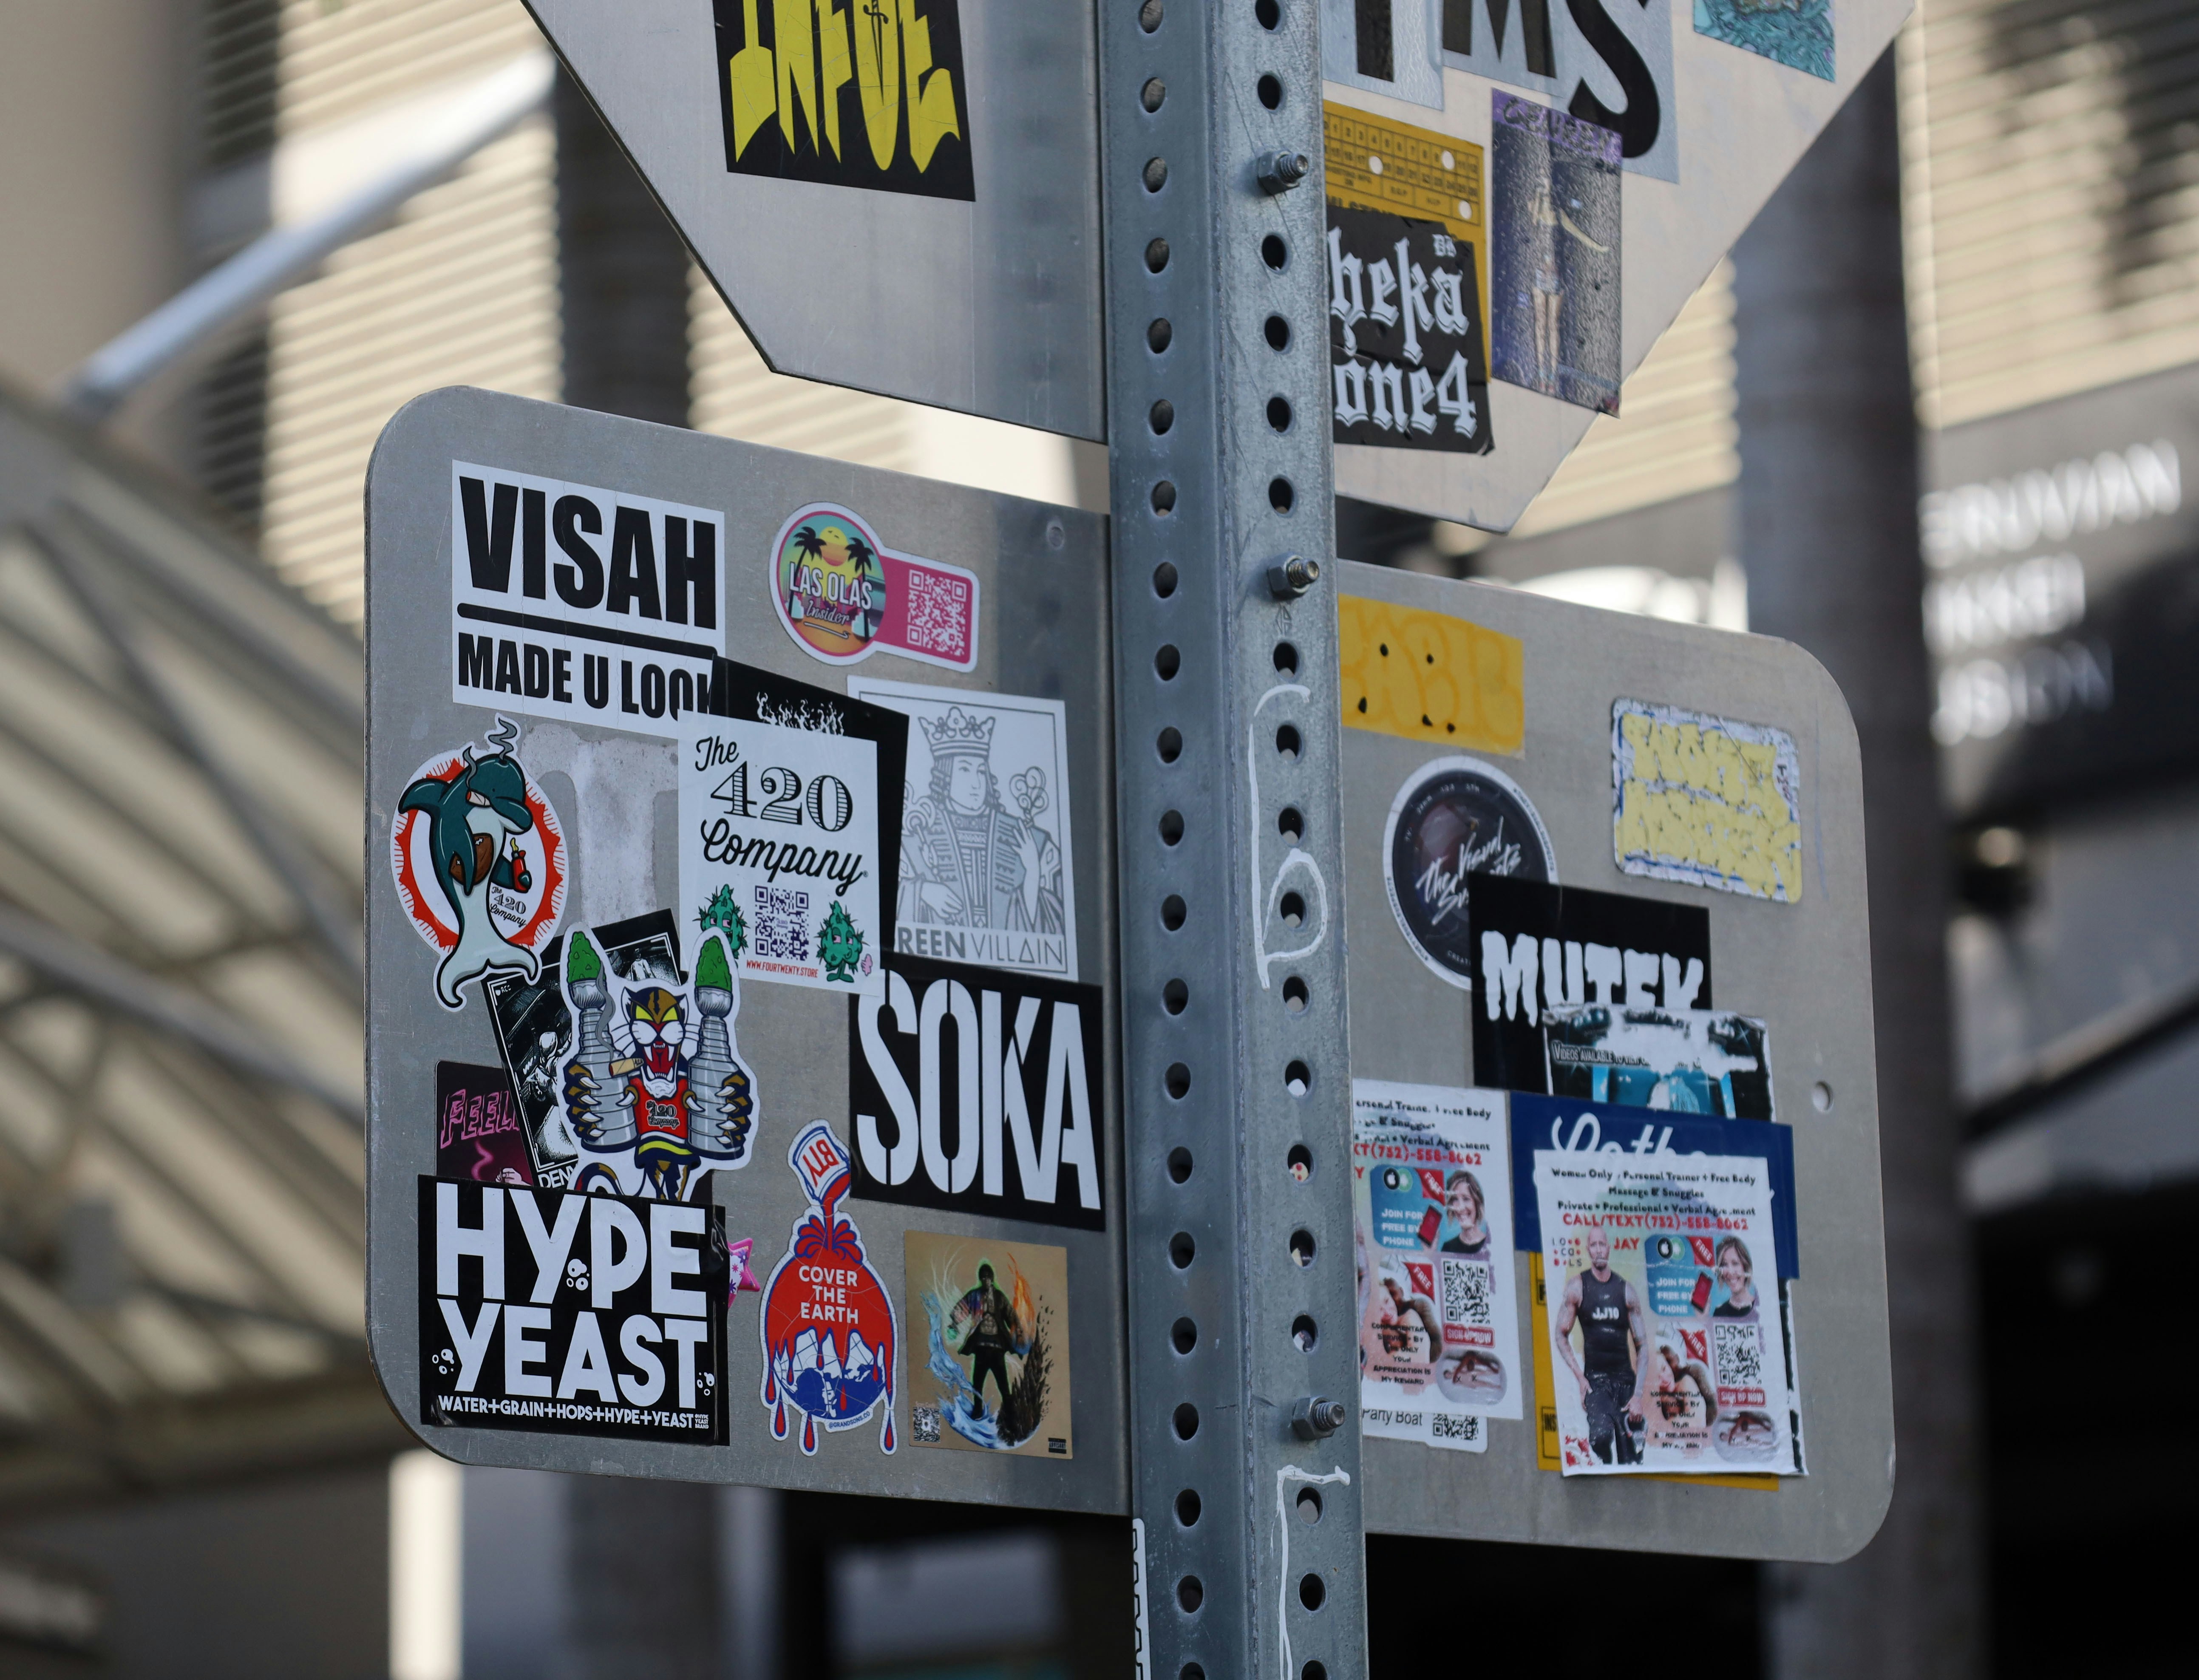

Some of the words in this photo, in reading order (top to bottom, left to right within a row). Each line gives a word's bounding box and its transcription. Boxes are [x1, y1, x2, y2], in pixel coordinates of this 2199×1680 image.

[459, 476, 716, 630] VISAH
[790, 561, 823, 597] LAS
[827, 572, 873, 610] OLAS
[806, 600, 850, 625] Insider
[459, 632, 572, 703] MADE
[584, 653, 608, 708] U
[695, 735, 739, 771] The
[710, 761, 853, 832] 420
[490, 904, 527, 927] Company
[494, 894, 526, 914] 420
[971, 933, 1063, 966] VILLAIN
[746, 959, 819, 978] WWW.FOURTWENTY.STORE
[857, 969, 1101, 1210] SOKA
[440, 1088, 520, 1149] FEEL
[802, 1139, 840, 1188] BTY
[1589, 1169, 1613, 1181] Only
[1663, 1187, 1705, 1200] Snuggles
[1382, 1210, 1403, 1218] JOIN
[1405, 1210, 1423, 1219] FOR
[1558, 1200, 1593, 1211] Private
[1603, 1201, 1661, 1213] Professional
[1672, 1203, 1703, 1214] Verbal
[1382, 1223, 1405, 1232] FREE
[437, 1183, 706, 1317] HYPE
[1383, 1236, 1414, 1246] PHONE
[1614, 1237, 1640, 1251] JAY
[1696, 1238, 1713, 1262] FREE
[799, 1265, 858, 1287] COVER
[1414, 1266, 1432, 1289] FREE
[812, 1285, 846, 1304] THE
[801, 1303, 859, 1324] EARTH
[437, 1298, 707, 1409] YEAST
[1688, 1332, 1706, 1356] FREE
[438, 1395, 694, 1428] WATER+GRAIN+HOPS+HYPE+YEAST
[829, 1411, 870, 1429] @GRANDSONS.CO
